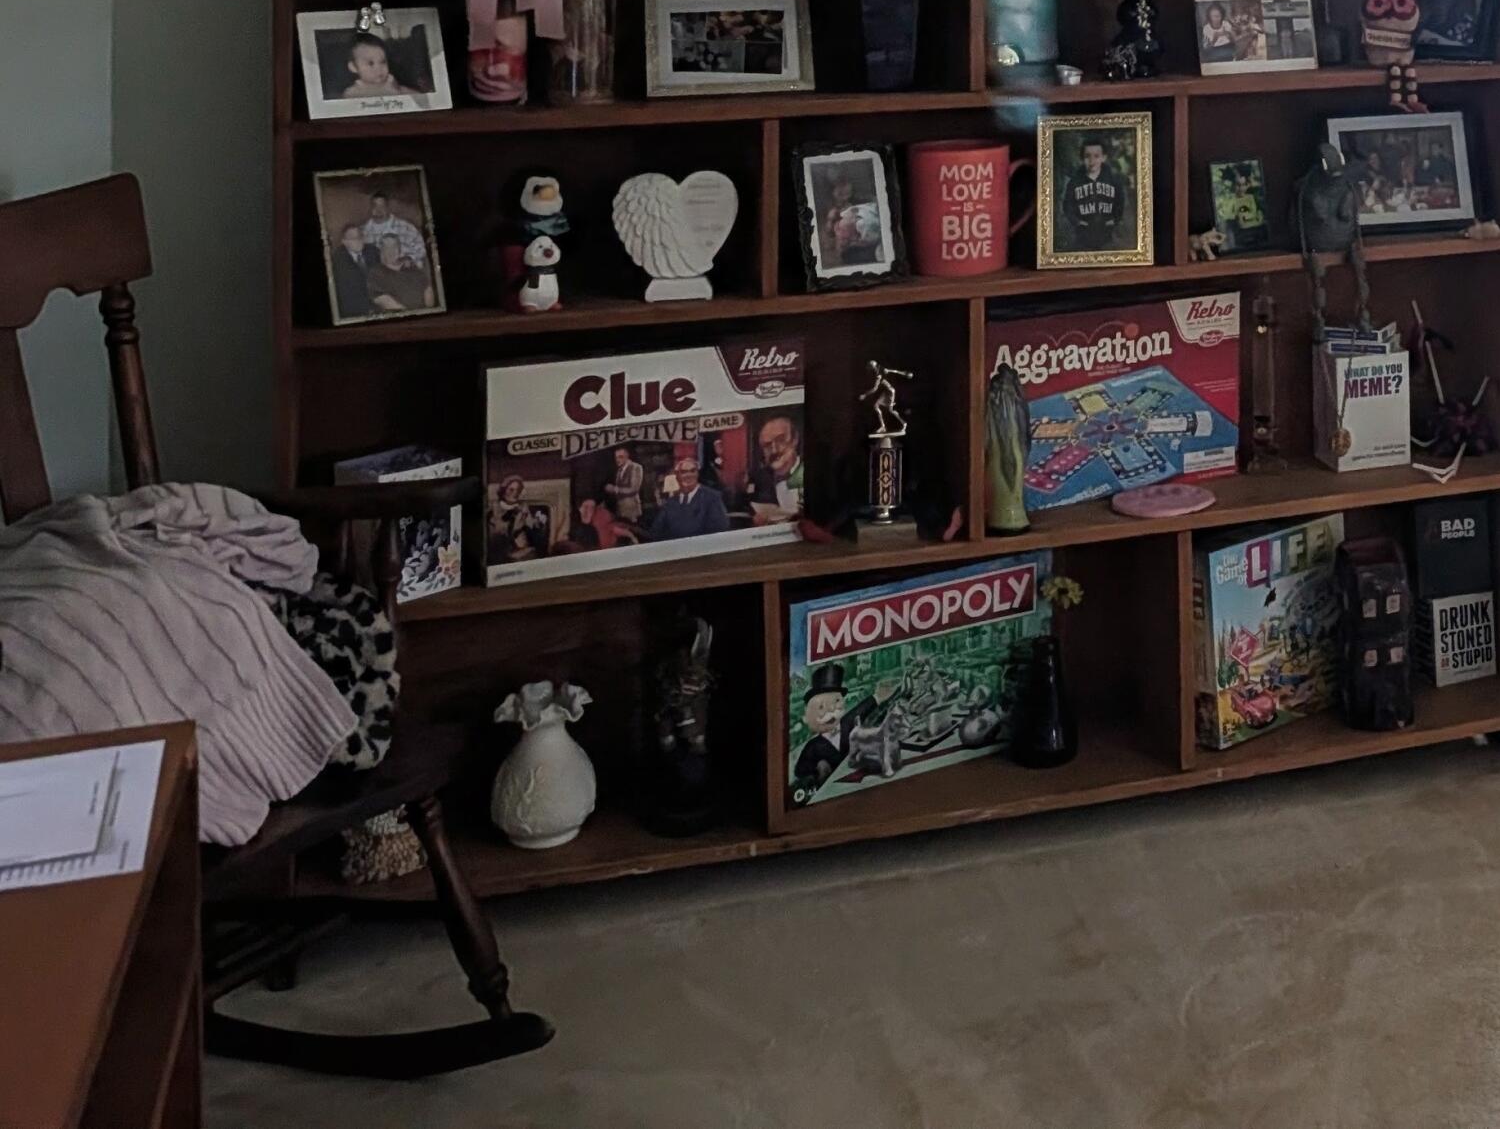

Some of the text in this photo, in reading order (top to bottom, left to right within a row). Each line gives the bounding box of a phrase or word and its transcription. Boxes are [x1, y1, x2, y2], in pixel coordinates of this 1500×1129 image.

[939, 162, 994, 182] MOM
[941, 181, 993, 201] LOVE
[942, 213, 993, 241] BIG
[941, 240, 993, 260] LOVE
[1187, 299, 1236, 321] Retro
[739, 345, 800, 371] Retro
[989, 330, 1173, 385] Aggravation
[1344, 362, 1403, 379] WHAT DO YOU
[563, 371, 697, 426] Clue
[1344, 374, 1404, 399] MEME?
[511, 415, 740, 457] CLASSIC DETECTIVE GAME
[1440, 518, 1476, 532] BAD
[1250, 523, 1329, 582] LIFE
[1216, 557, 1249, 585] Game
[816, 573, 1030, 654] MONOPOLY
[1439, 601, 1491, 633] DRUNK
[1440, 625, 1493, 654] STONED
[1452, 647, 1493, 669] STUPID
